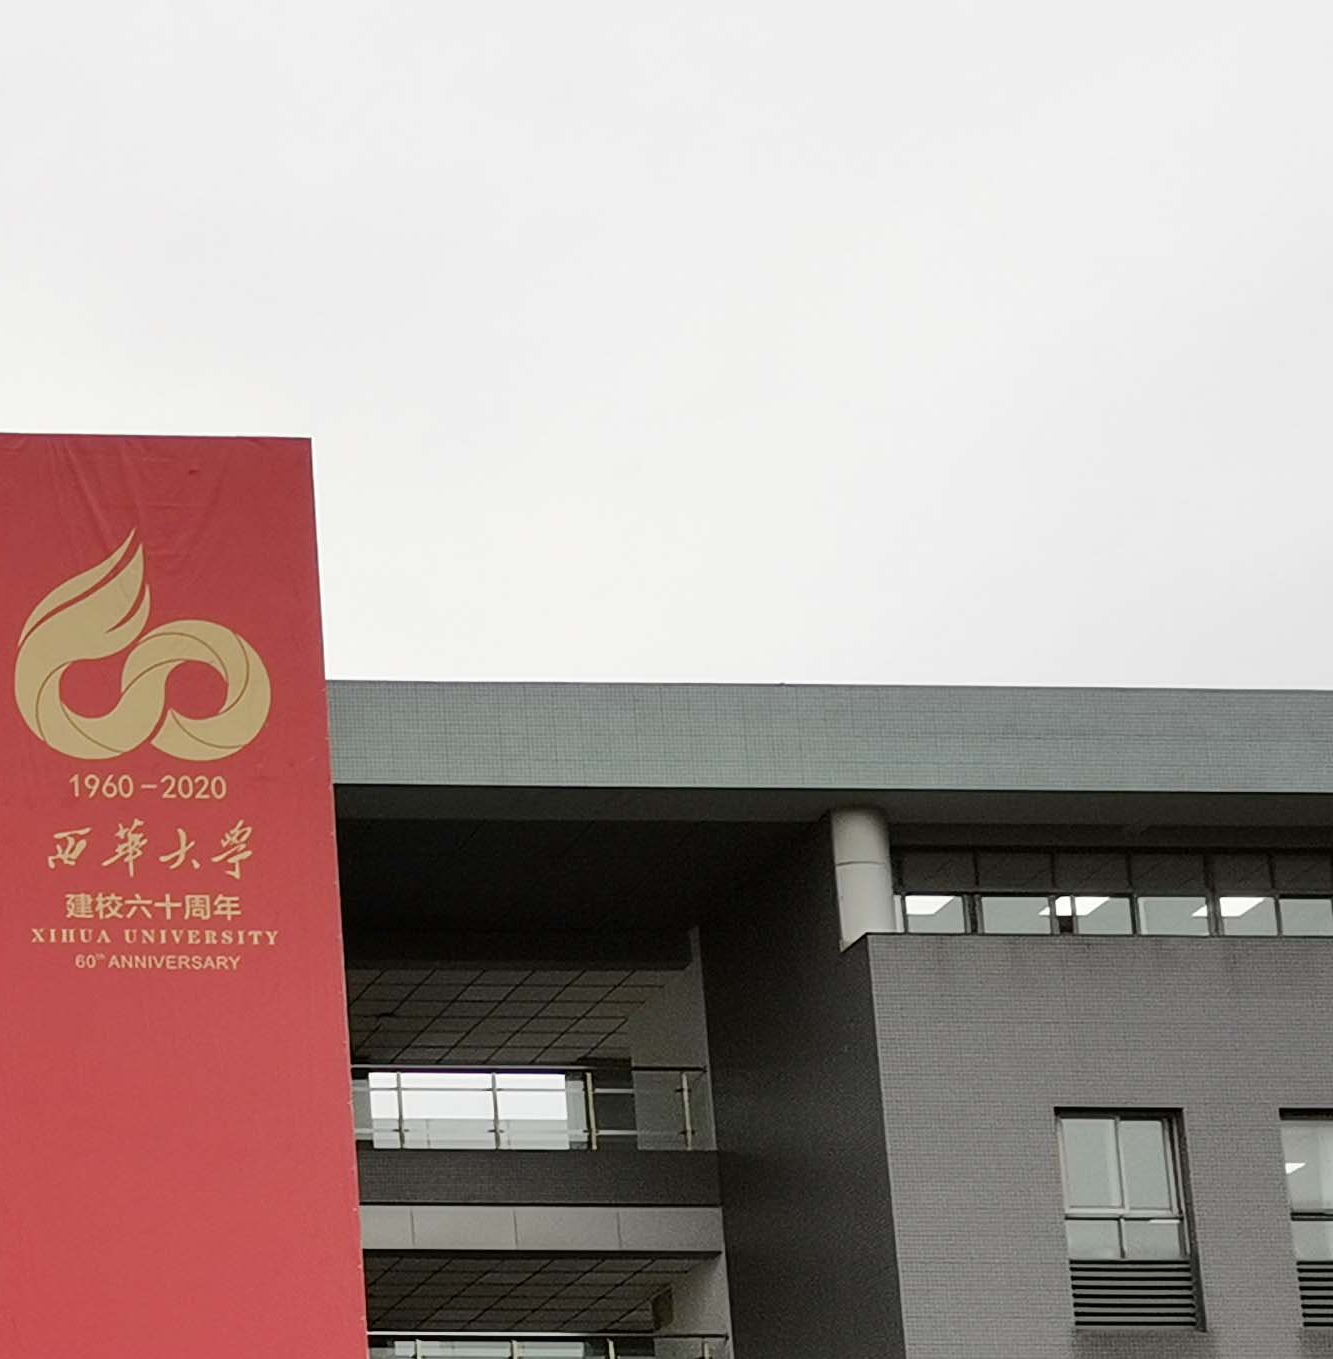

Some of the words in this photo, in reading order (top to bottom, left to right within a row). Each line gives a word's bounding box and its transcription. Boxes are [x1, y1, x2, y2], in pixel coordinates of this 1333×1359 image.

[65, 893, 242, 921] 建校六十周年
[31, 928, 111, 944] XIHUA
[124, 929, 279, 946] UNIVERSITY
[108, 954, 241, 970] ANNIVERSARY
